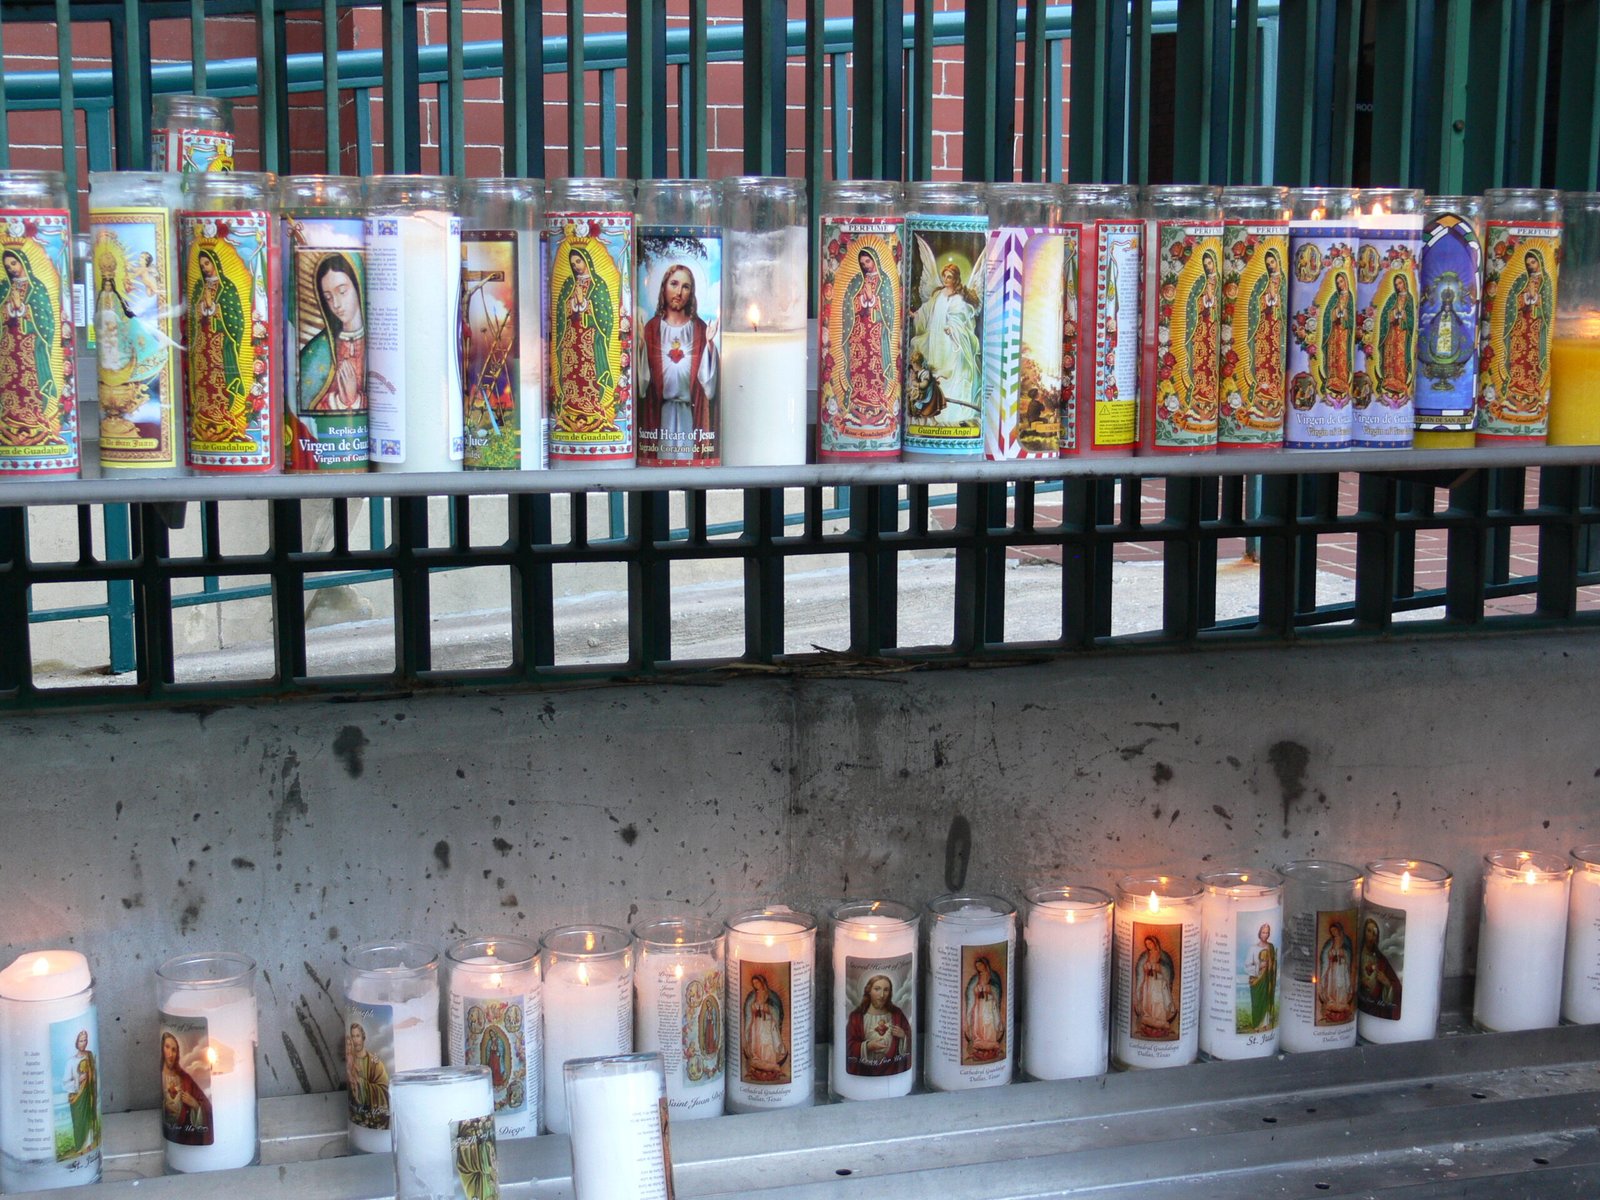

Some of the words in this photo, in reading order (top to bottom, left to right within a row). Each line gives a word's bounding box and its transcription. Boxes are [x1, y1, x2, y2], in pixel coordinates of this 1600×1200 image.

[849, 224, 888, 232] PERFUME
[1296, 413, 1325, 426] Virgen
[1327, 414, 1335, 424] de
[1352, 412, 1380, 424] Virgen
[1382, 413, 1391, 424] de
[328, 426, 356, 437] Replica
[357, 425, 364, 433] de
[639, 427, 658, 440] Sacred
[660, 428, 685, 440] Heart
[687, 428, 698, 440] of
[698, 428, 715, 442] Jesus
[918, 427, 952, 435] Guardian
[953, 428, 971, 436] Angel
[571, 433, 580, 441] de
[581, 433, 621, 442] Guadalupe
[12, 447, 22, 455] de
[23, 446, 67, 456] Guadalupe
[211, 443, 255, 452] Guadalupe
[299, 438, 336, 455] Virgen
[338, 438, 351, 451] de
[692, 443, 700, 453] de
[313, 453, 341, 465] Virgin
[342, 453, 351, 462] of
[1246, 1035, 1259, 1046] St.
[688, 1097, 710, 1110] Juan
[498, 1125, 526, 1137] Diego
